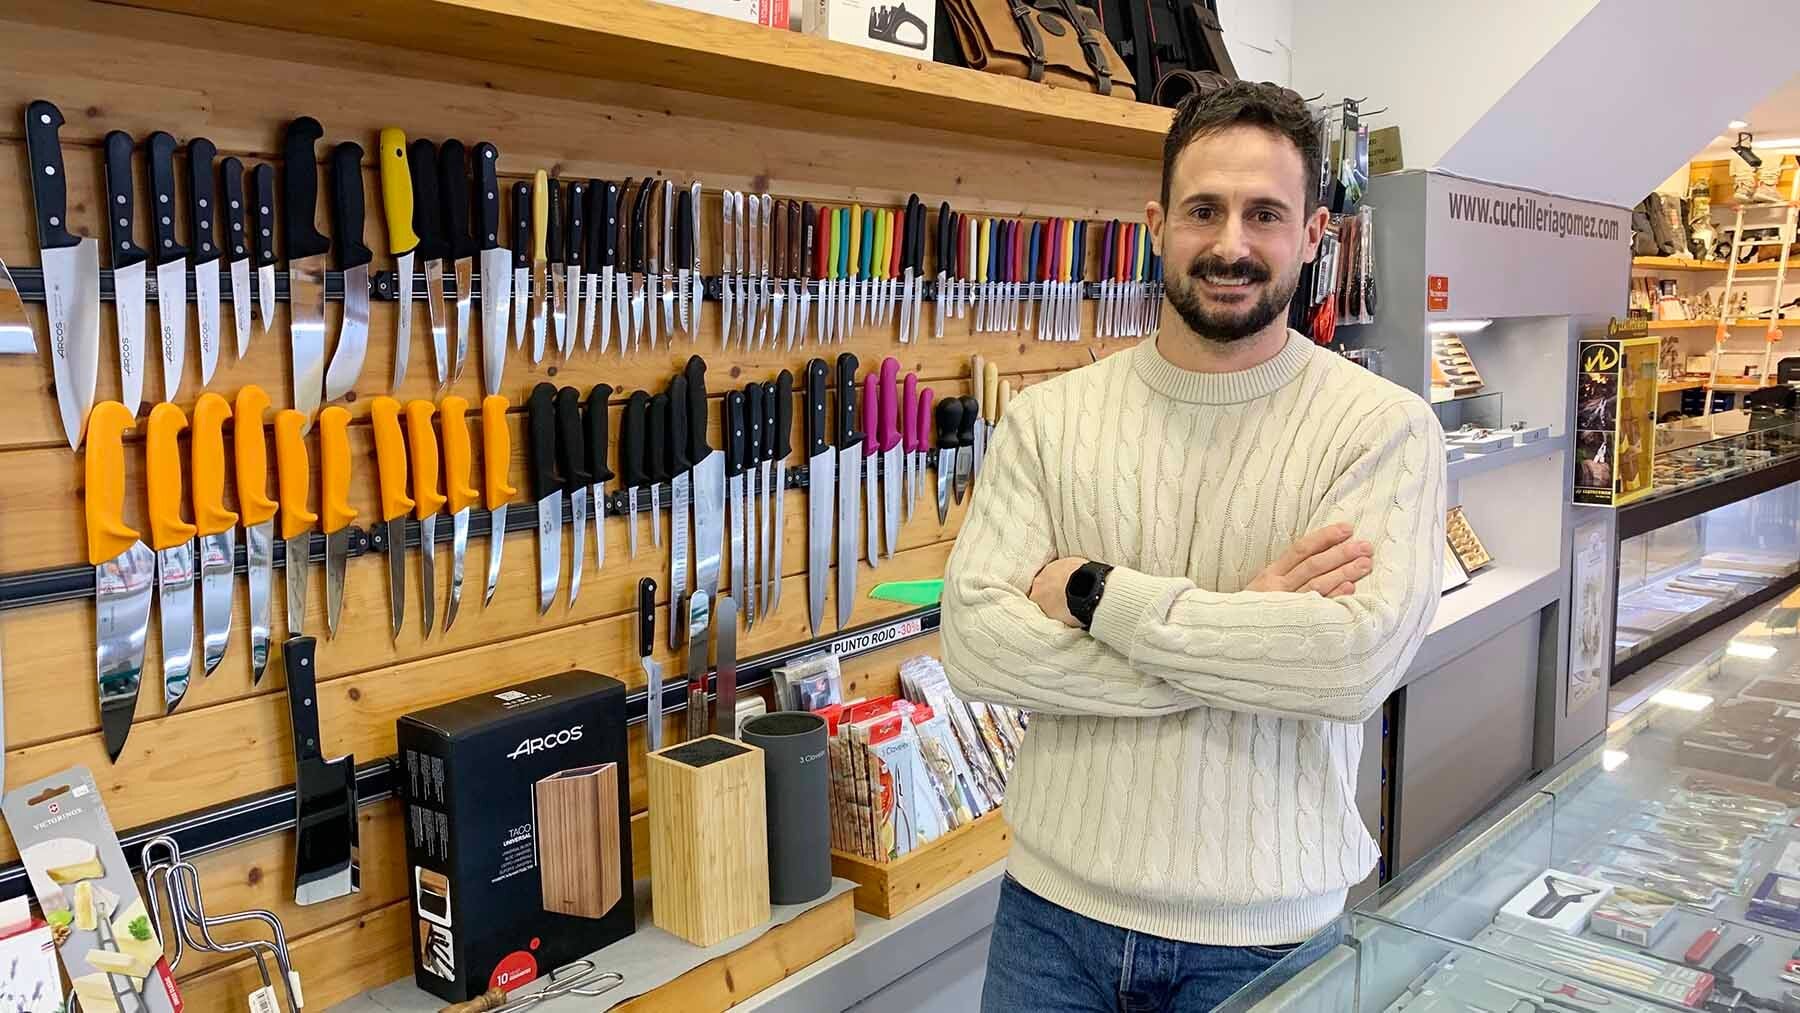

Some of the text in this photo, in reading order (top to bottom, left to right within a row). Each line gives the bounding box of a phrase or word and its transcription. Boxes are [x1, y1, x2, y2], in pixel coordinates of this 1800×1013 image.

[1449, 192, 1619, 239] www.cuchilleriagomez.com
[56, 322, 64, 359] ARCOS
[122, 337, 131, 376] ARCOS
[164, 325, 173, 363] ARCOS
[834, 635, 870, 654] PUNTO
[871, 627, 896, 644] ROJO
[506, 724, 584, 760] ARCOS
[33, 807, 83, 832] VICTORINOX
[509, 823, 532, 838] TACO
[496, 972, 509, 987] 10
